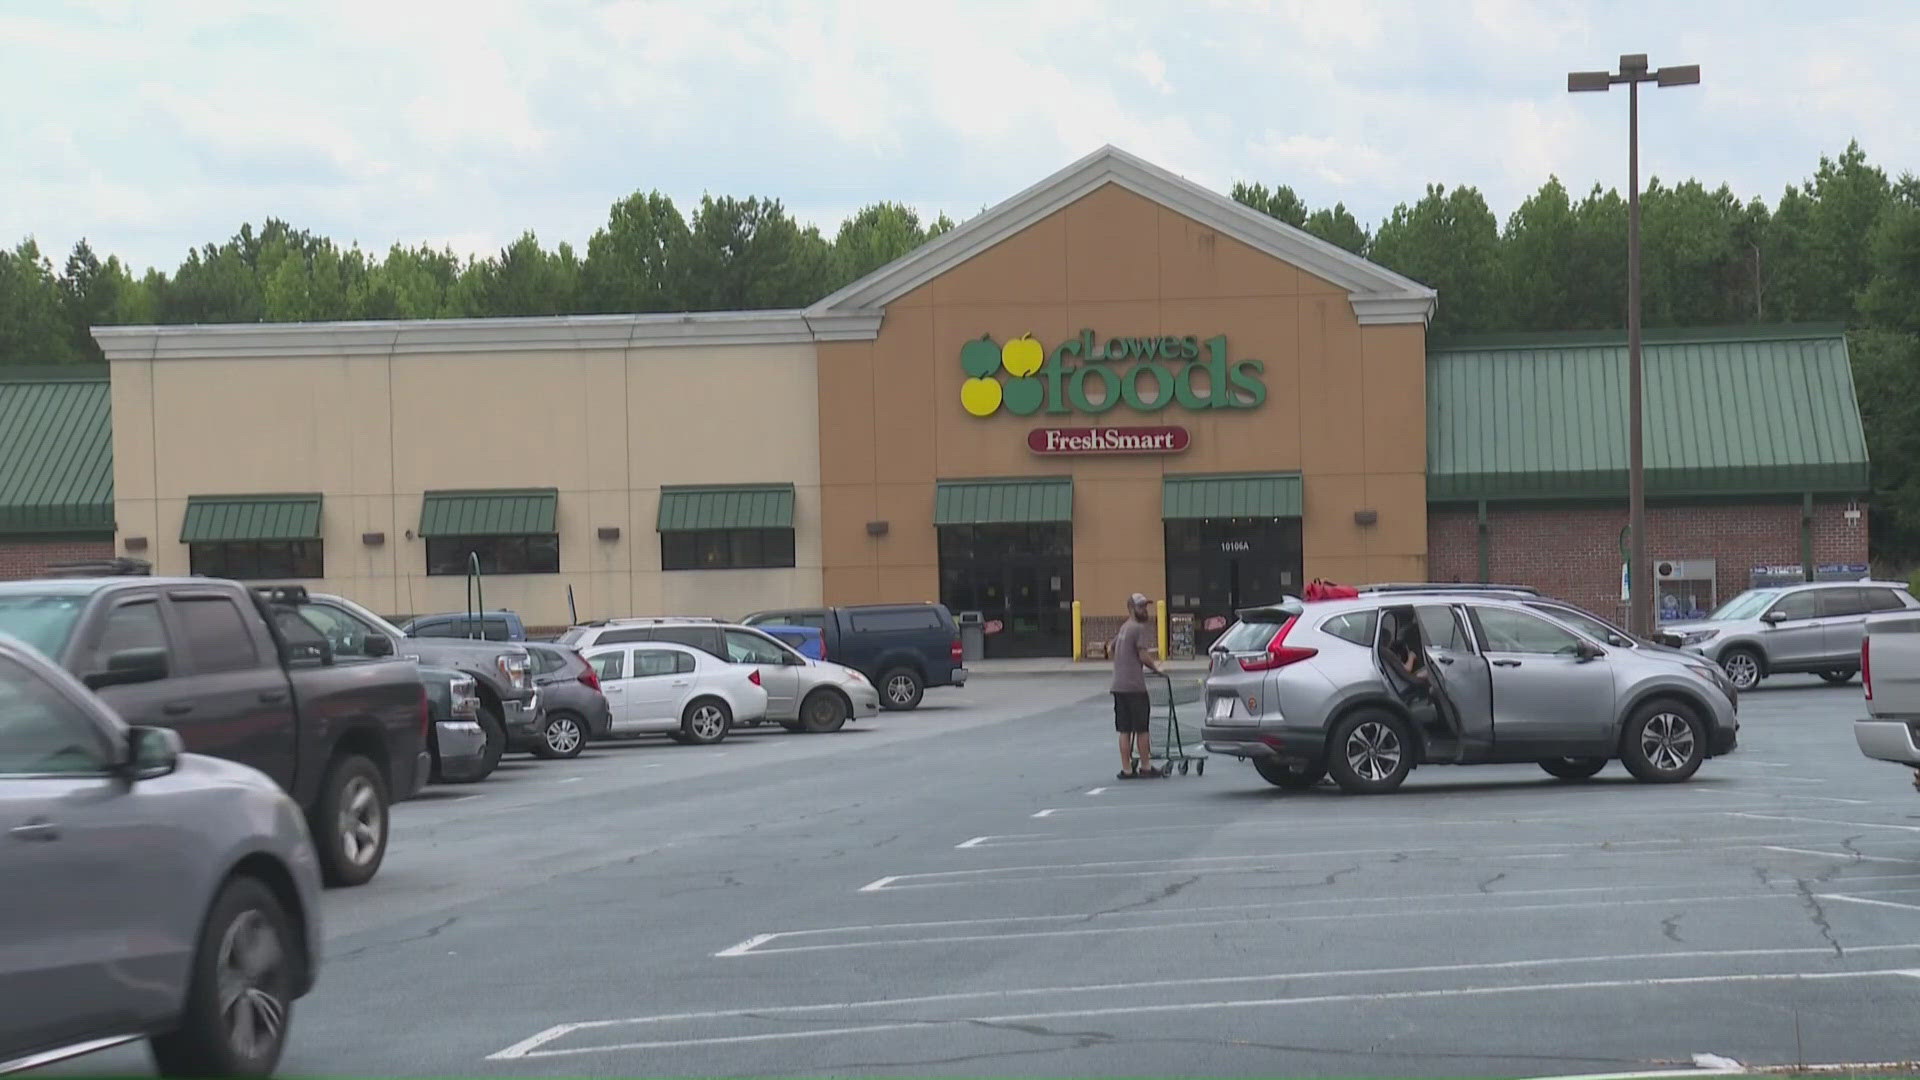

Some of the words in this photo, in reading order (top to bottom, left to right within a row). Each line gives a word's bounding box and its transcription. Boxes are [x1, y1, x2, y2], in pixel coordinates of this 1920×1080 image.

[1080, 328, 1198, 361] Lowes
[1040, 334, 1266, 414] foods
[1045, 429, 1174, 450] FreshSmart
[1220, 541, 1249, 552] 10106A
